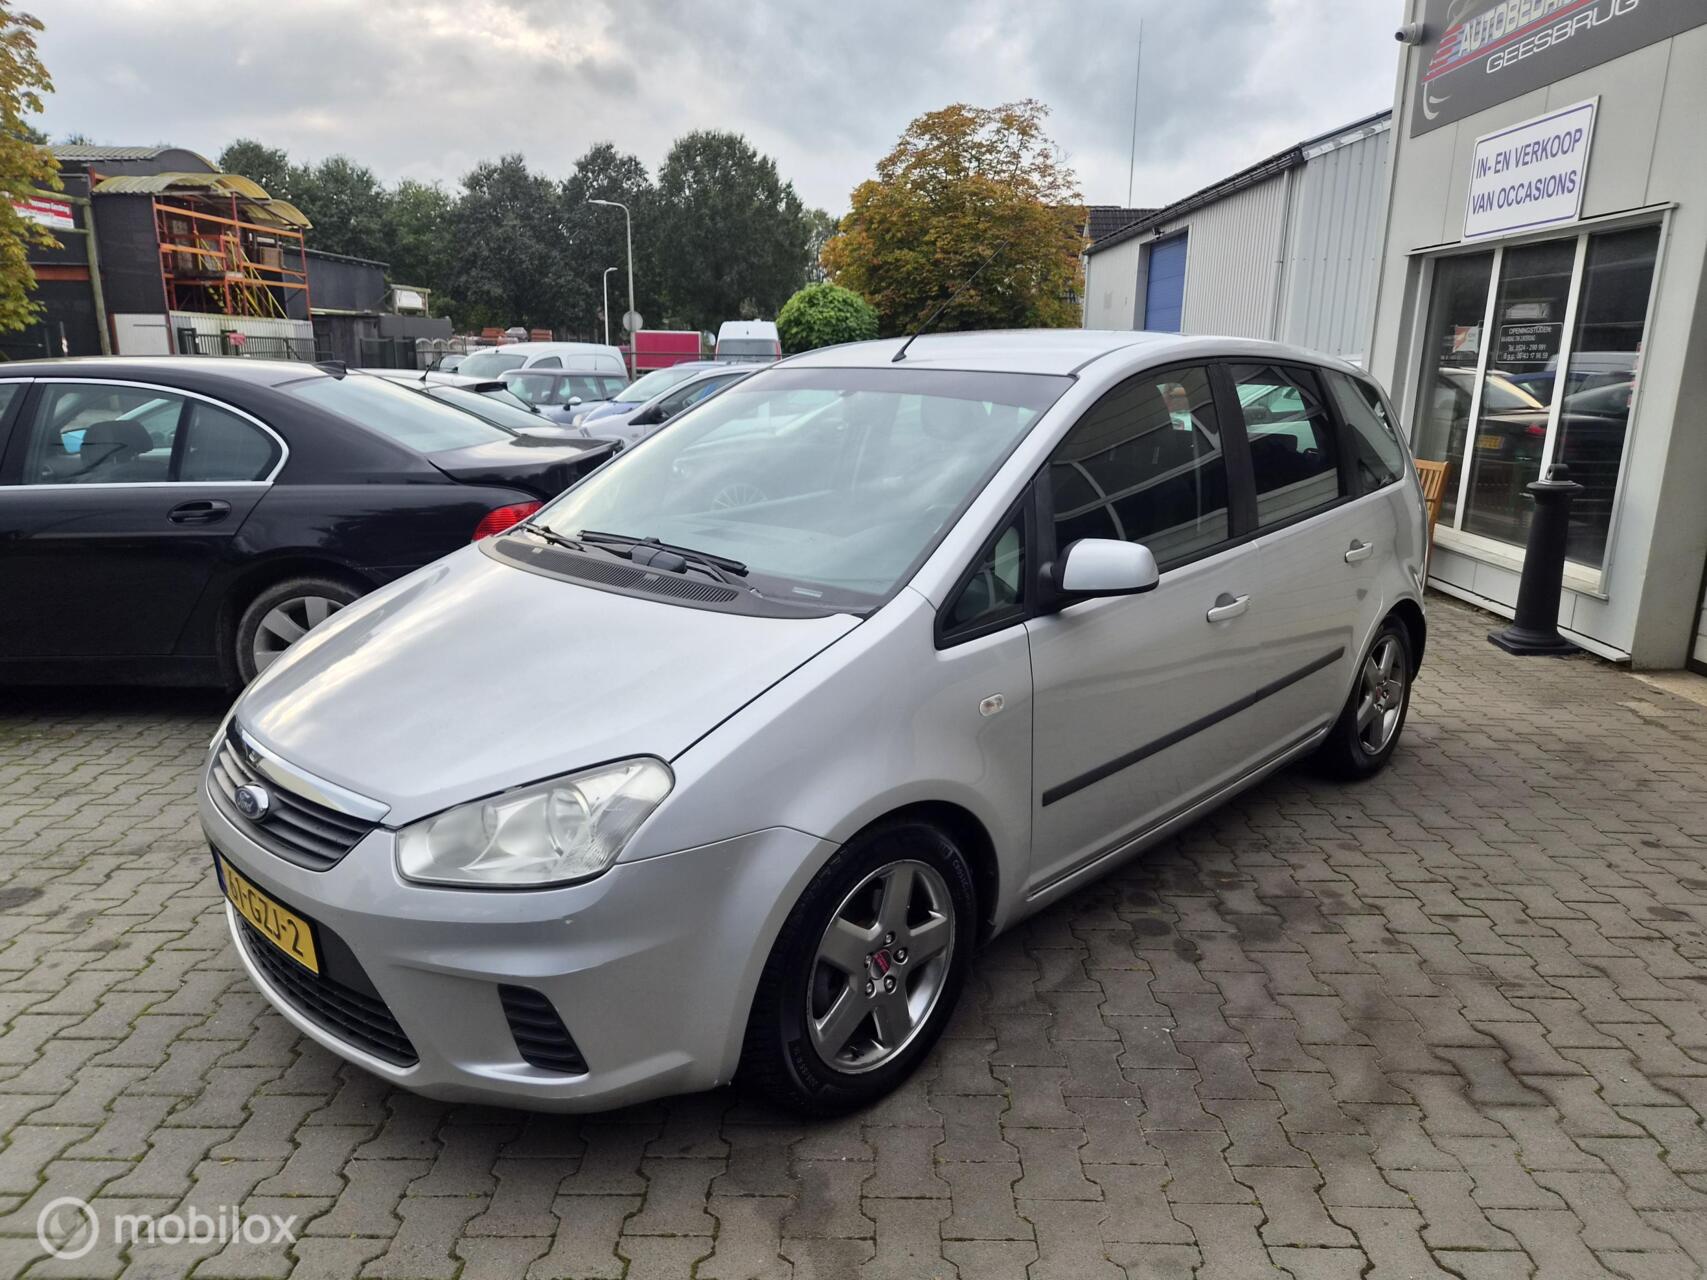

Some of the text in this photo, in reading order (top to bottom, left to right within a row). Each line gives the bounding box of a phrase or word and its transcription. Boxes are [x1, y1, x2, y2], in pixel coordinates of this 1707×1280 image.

[1486, 0, 1639, 73] GEESBRUG
[1476, 128, 1583, 179] IN- EN VERKOOP
[1472, 170, 1577, 215] VAN OCCASIONS
[228, 869, 304, 957] 61-GZJ-2
